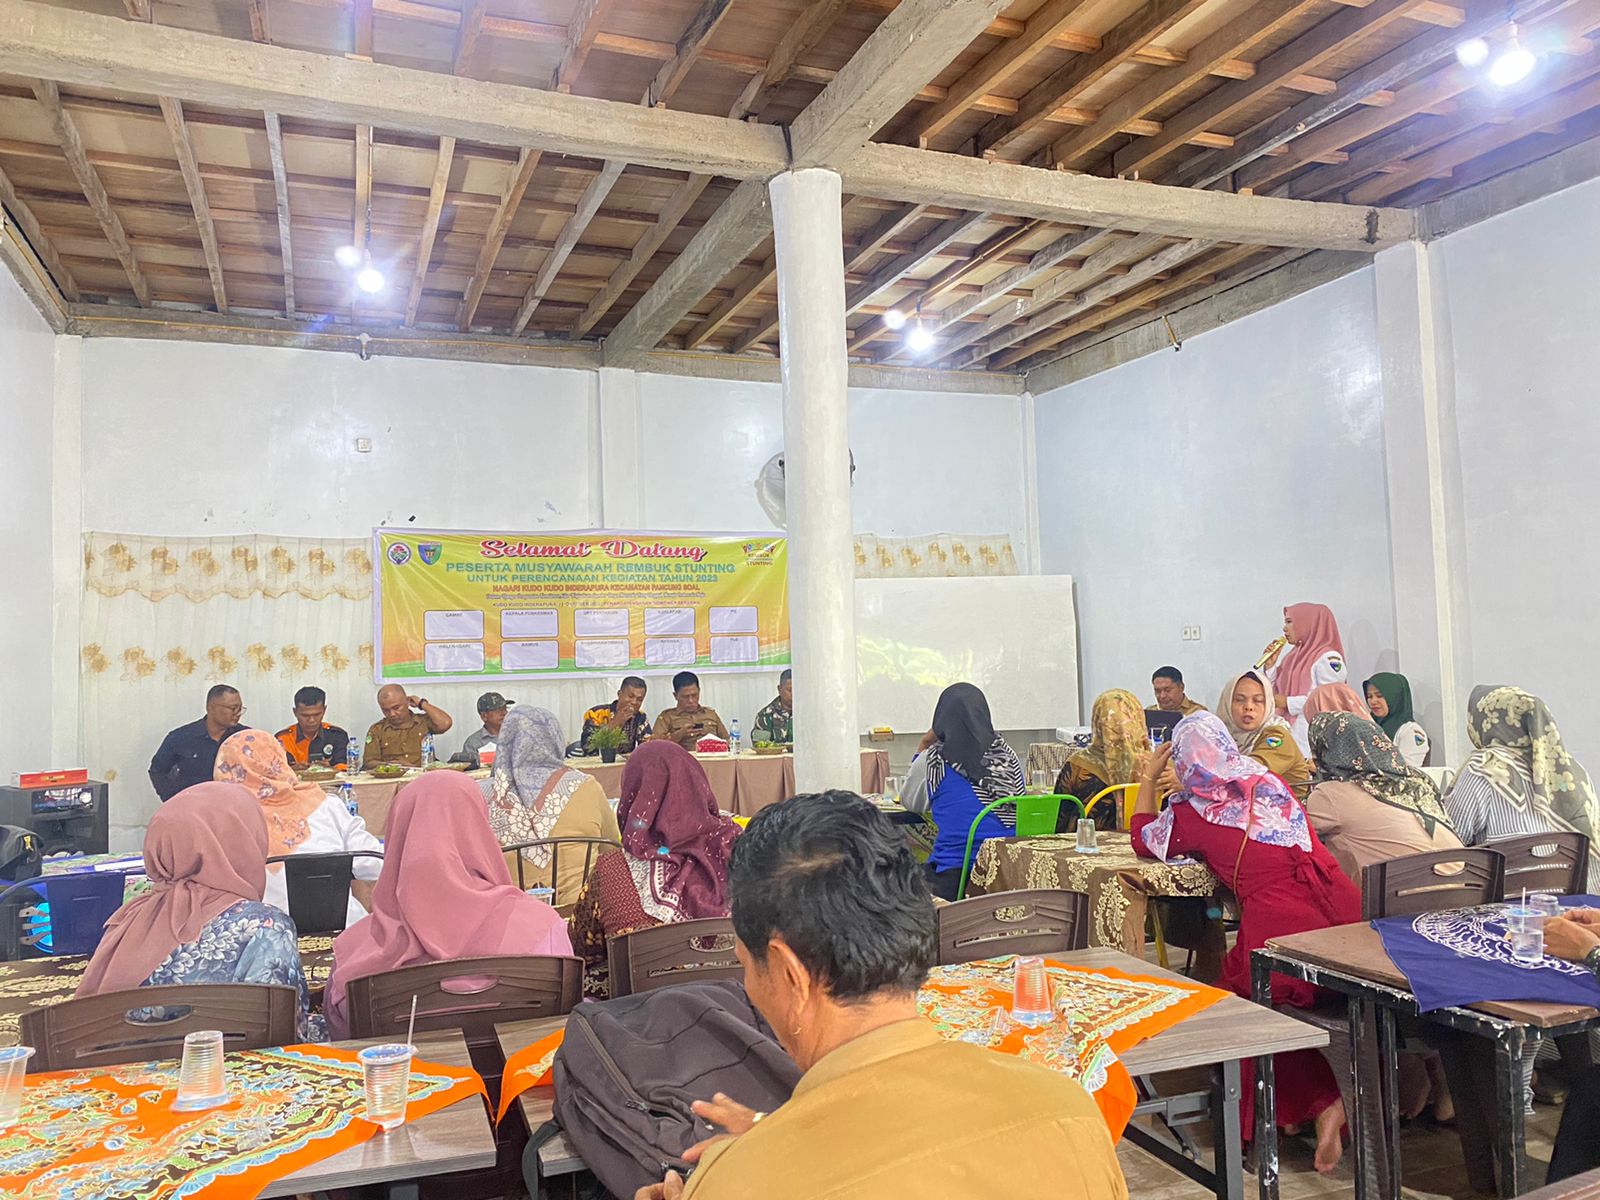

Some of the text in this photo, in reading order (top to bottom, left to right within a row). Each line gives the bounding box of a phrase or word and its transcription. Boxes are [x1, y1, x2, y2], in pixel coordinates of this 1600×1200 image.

[480, 539, 708, 562] Selamat Datang
[446, 563, 736, 573] PESERTA MUSYAWARAH REMBUK STUNTING
[467, 574, 508, 582] UNTUK
[511, 574, 599, 582] PERENCANAAN
[603, 574, 656, 582] KEGIATAN
[658, 574, 693, 582] TAHUN
